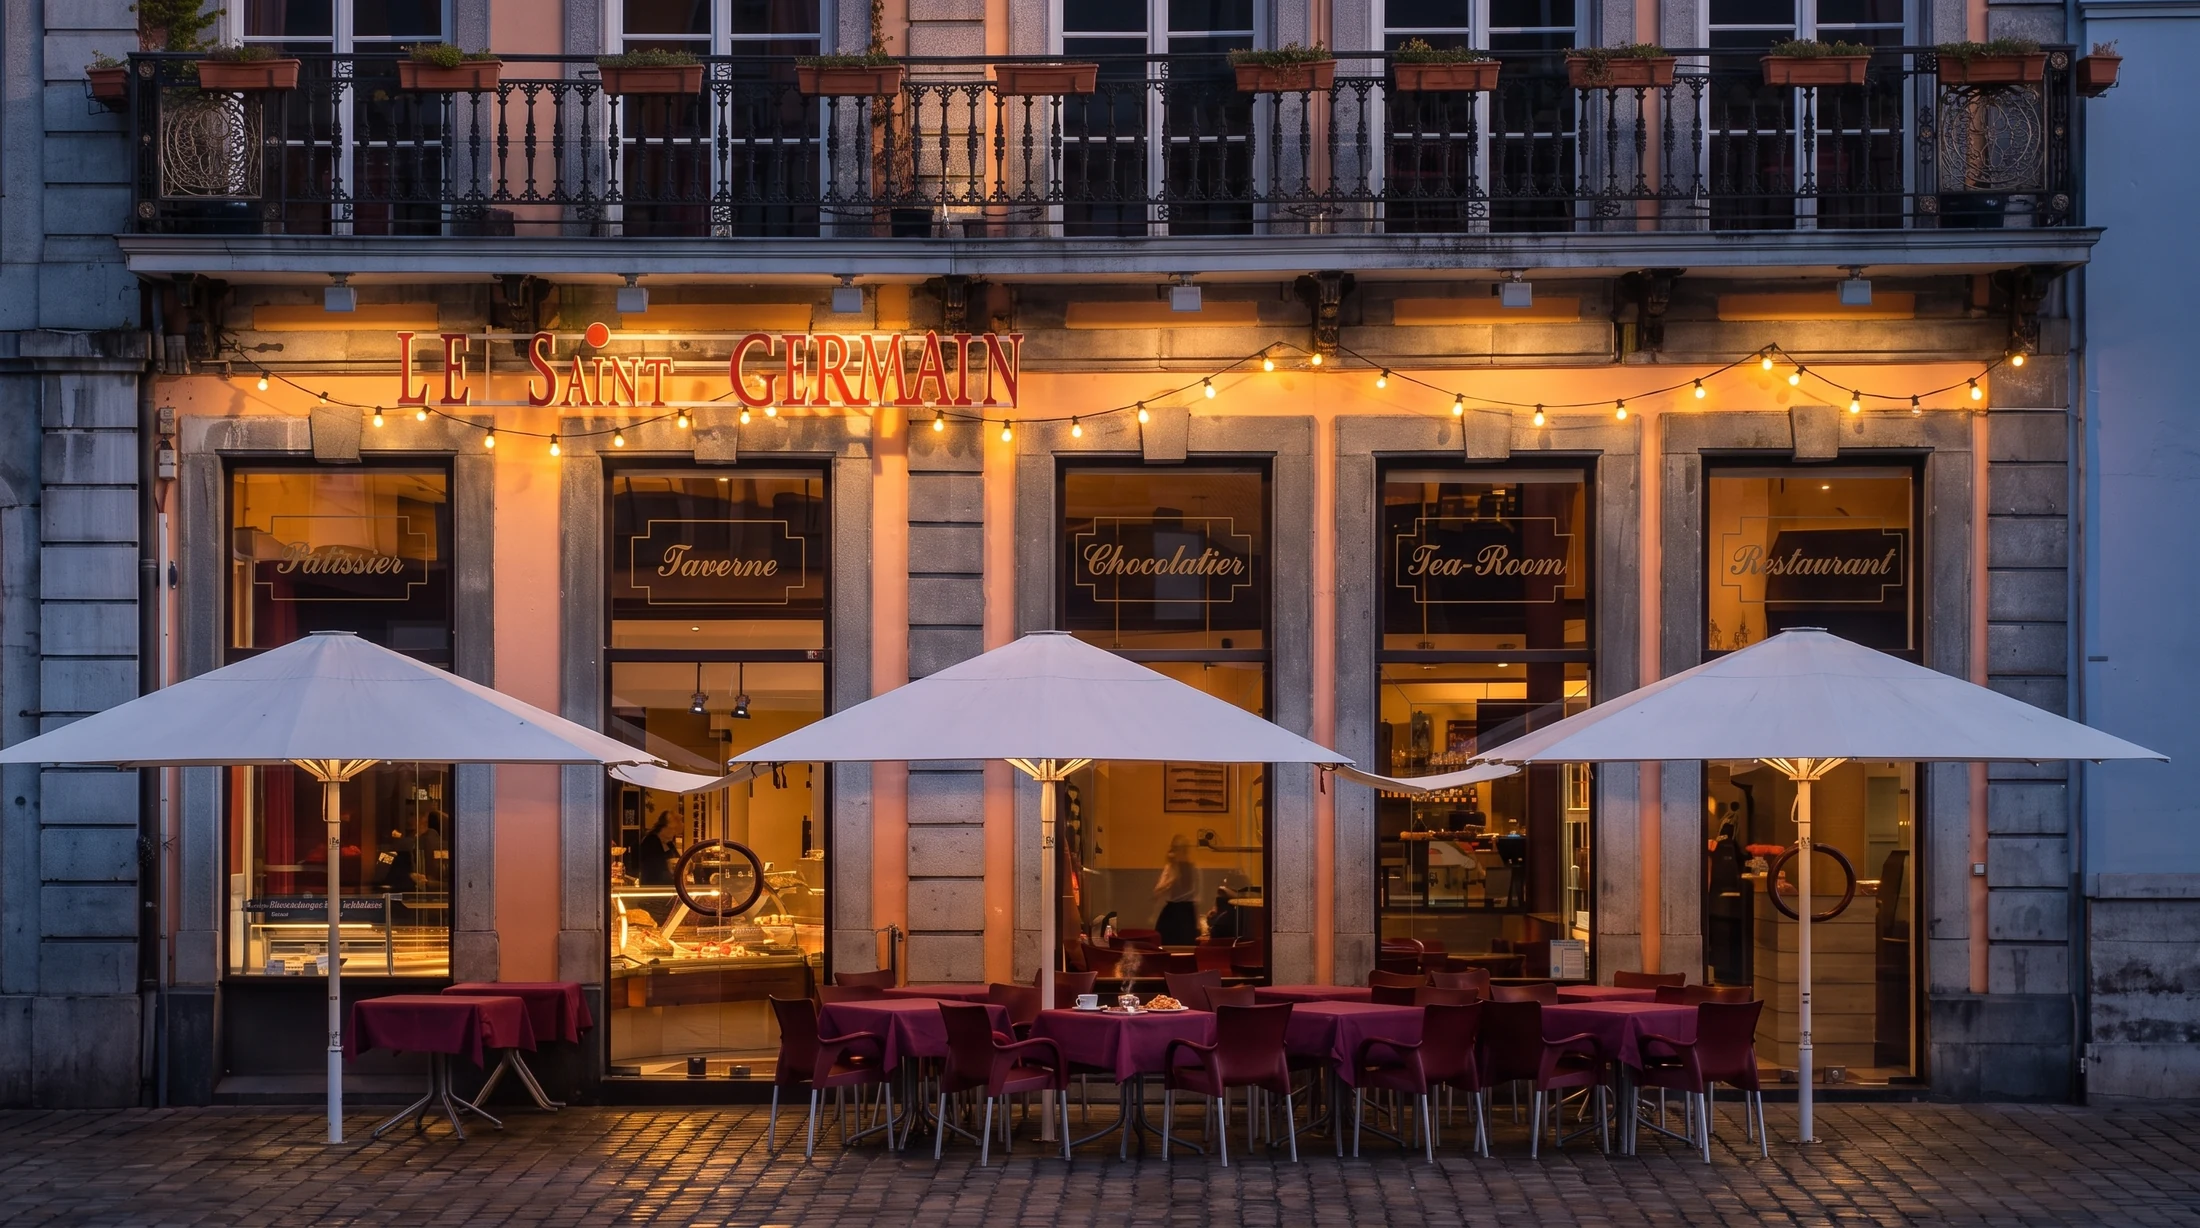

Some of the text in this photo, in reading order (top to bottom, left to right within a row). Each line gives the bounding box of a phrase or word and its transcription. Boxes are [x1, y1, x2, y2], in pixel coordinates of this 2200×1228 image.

[396, 330, 471, 407] LE
[729, 329, 1025, 409] GERMAIN
[657, 544, 778, 577] Taverne
[1083, 543, 1245, 576] Chocolatier
[1407, 544, 1567, 576] Tea-Room
[1730, 544, 1896, 575] Restaurant
